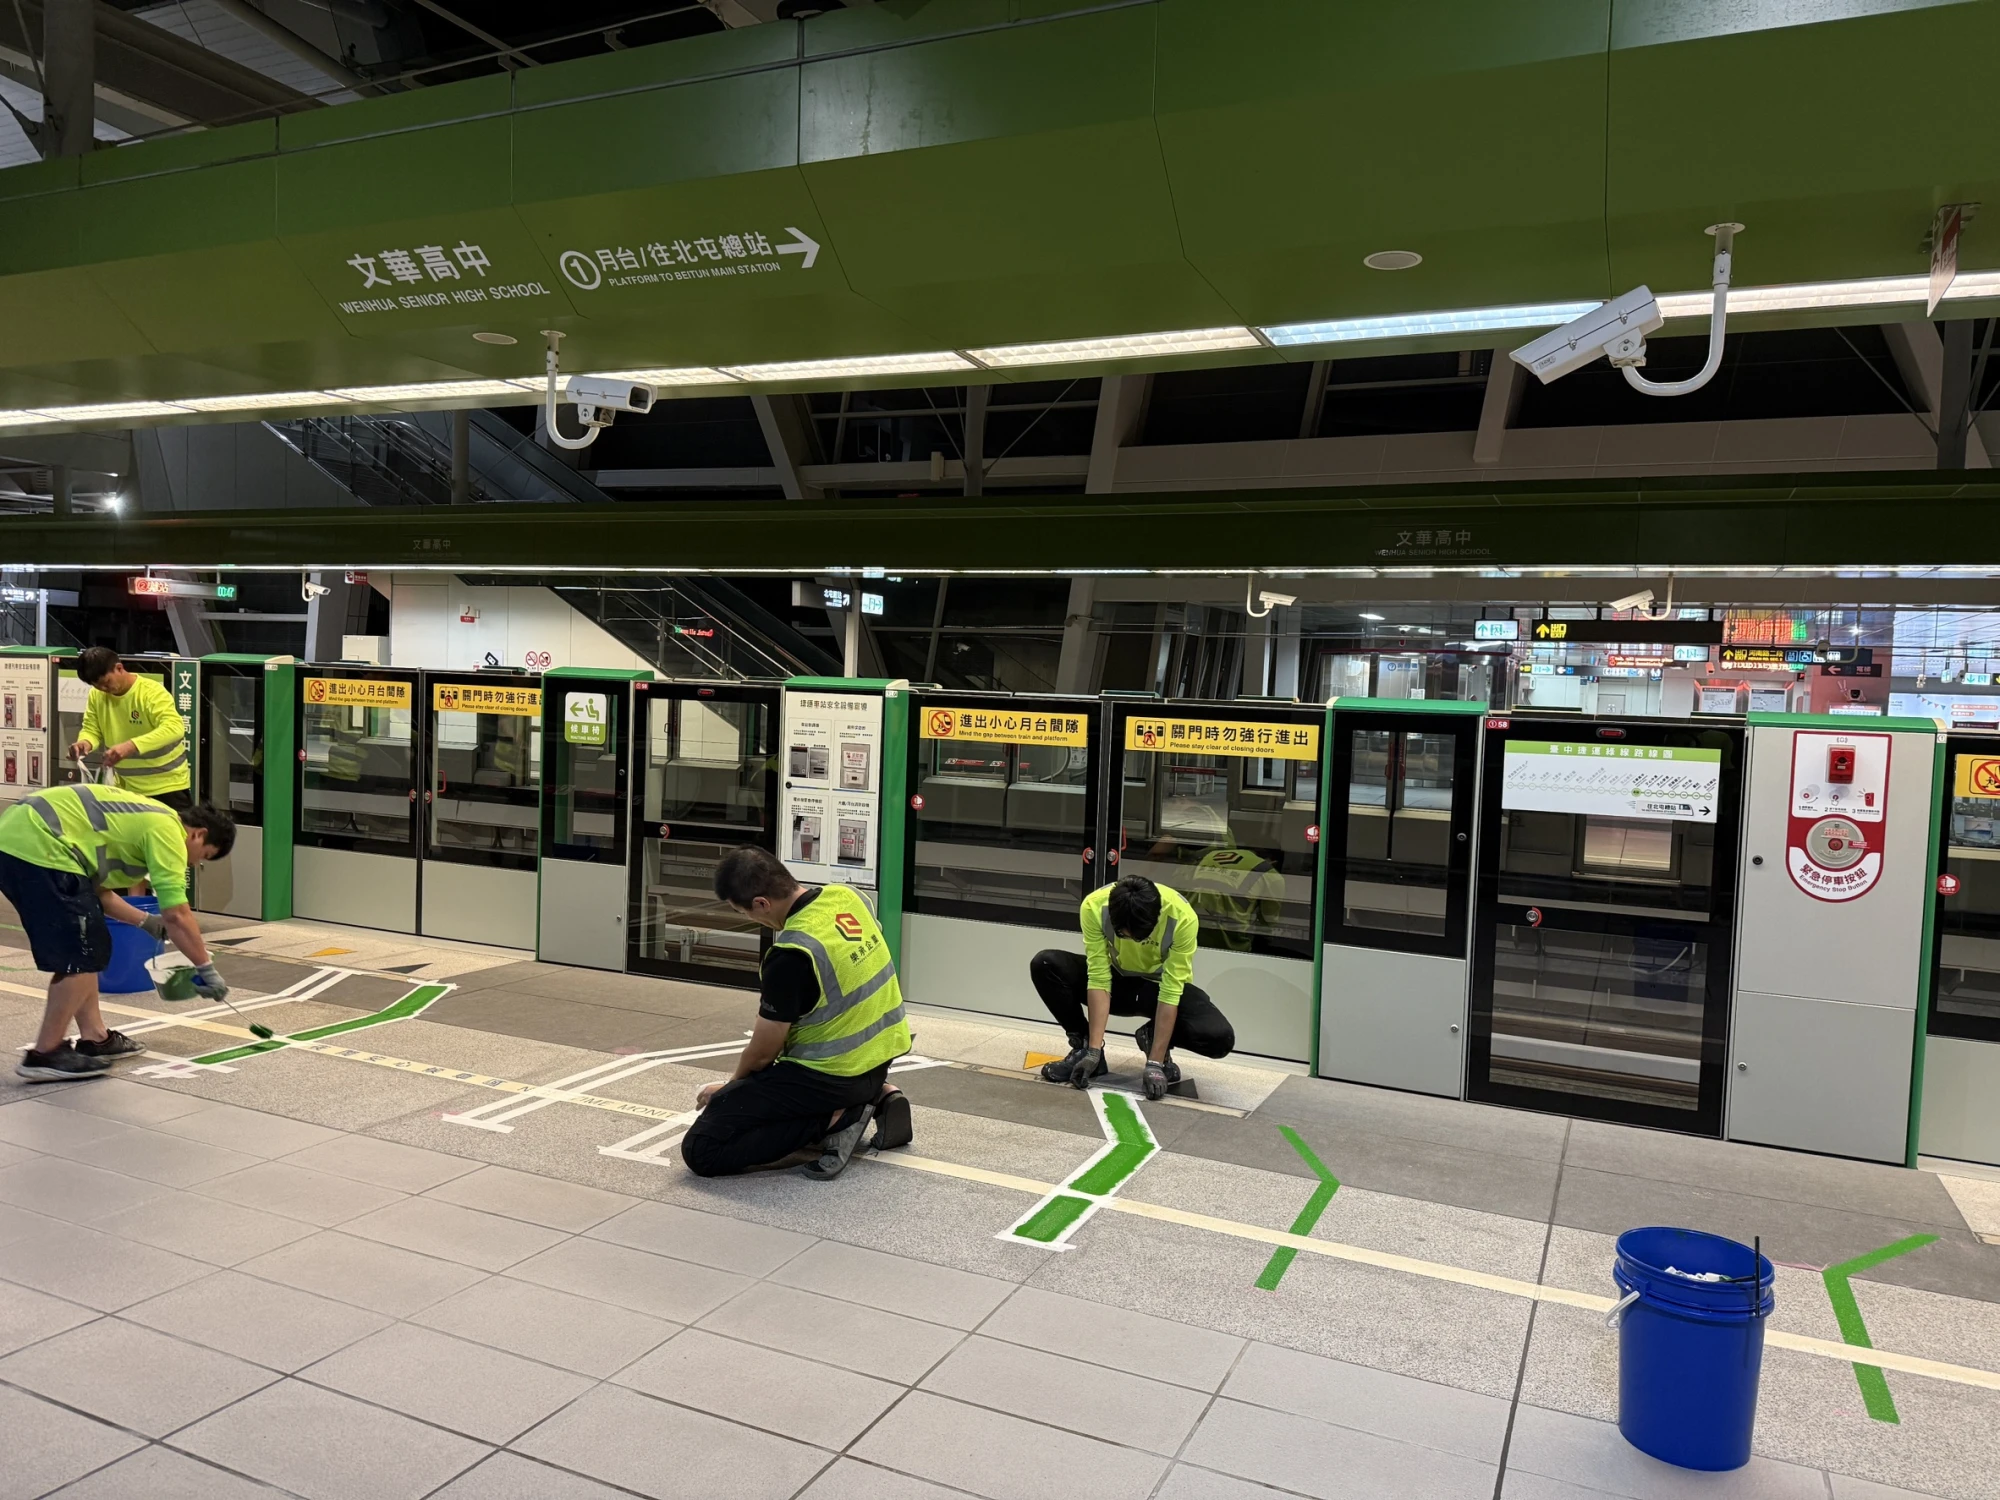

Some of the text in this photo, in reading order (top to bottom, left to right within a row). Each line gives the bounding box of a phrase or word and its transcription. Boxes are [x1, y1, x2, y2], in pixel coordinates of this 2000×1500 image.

[595, 231, 773, 272] 月台/往北屯總站
[346, 240, 491, 289] 文華高中
[608, 262, 781, 287] PLATFORM TO BEITUN MAIN STATION
[339, 282, 551, 314] WENHUA SENIOR HIGH SCHOOL
[1396, 529, 1471, 546] 文華高中
[328, 682, 406, 698] 進出小心月台間隙
[462, 689, 541, 706] 關門時勿強行進
[570, 724, 600, 735] 候車椅
[960, 713, 1079, 734] 進出小心月台間隙
[1171, 723, 1309, 746] 關門時勿強行進出
[1550, 744, 1673, 759] 臺中捷運綠線路線圖
[1799, 874, 1831, 892] Emergency
[1848, 880, 1868, 890] Button
[1800, 863, 1868, 886] 緊急停車按鈕
